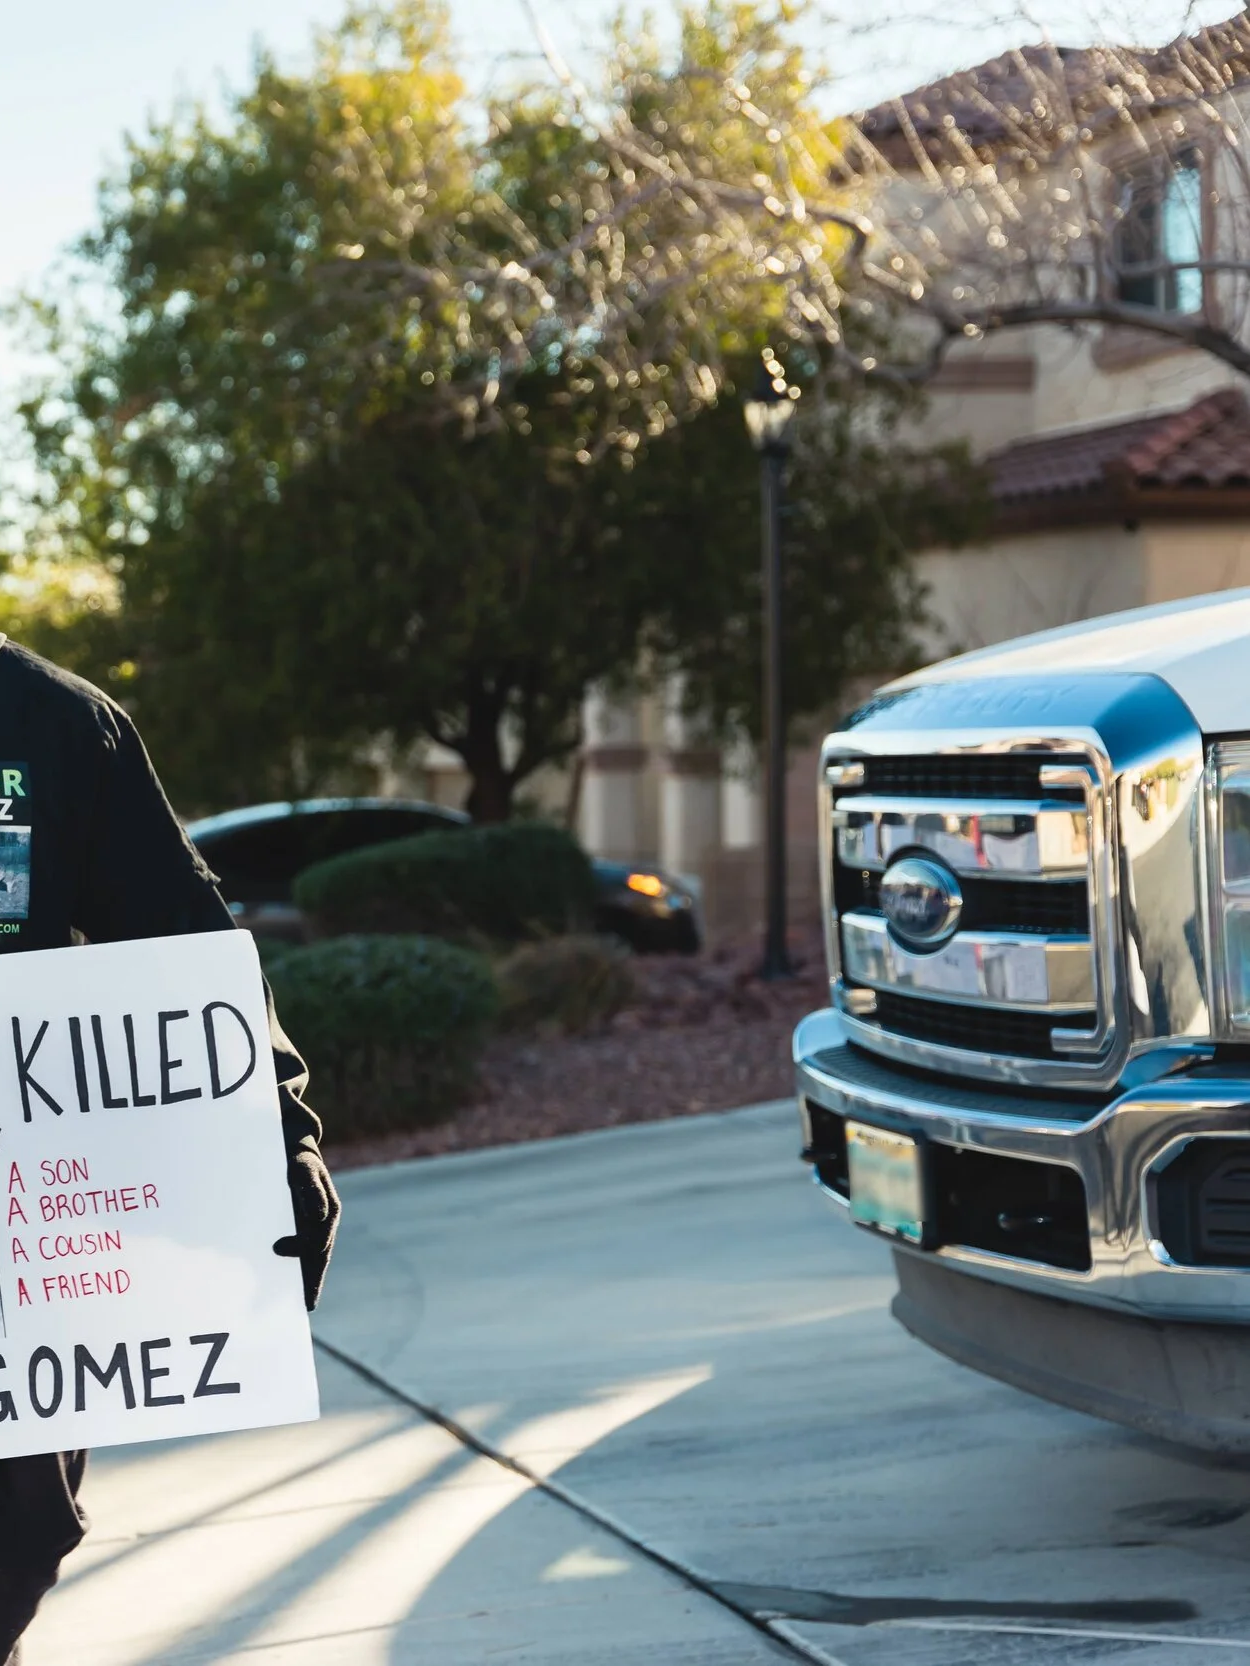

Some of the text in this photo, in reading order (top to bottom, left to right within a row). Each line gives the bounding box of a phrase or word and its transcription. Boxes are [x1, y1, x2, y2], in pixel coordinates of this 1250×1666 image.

[12, 1001, 256, 1123] KILLED
[7, 1157, 90, 1193] A SON
[7, 1183, 160, 1226] A BROTHER
[11, 1230, 122, 1264] A COUSIN
[17, 1269, 131, 1306] A FRIEND
